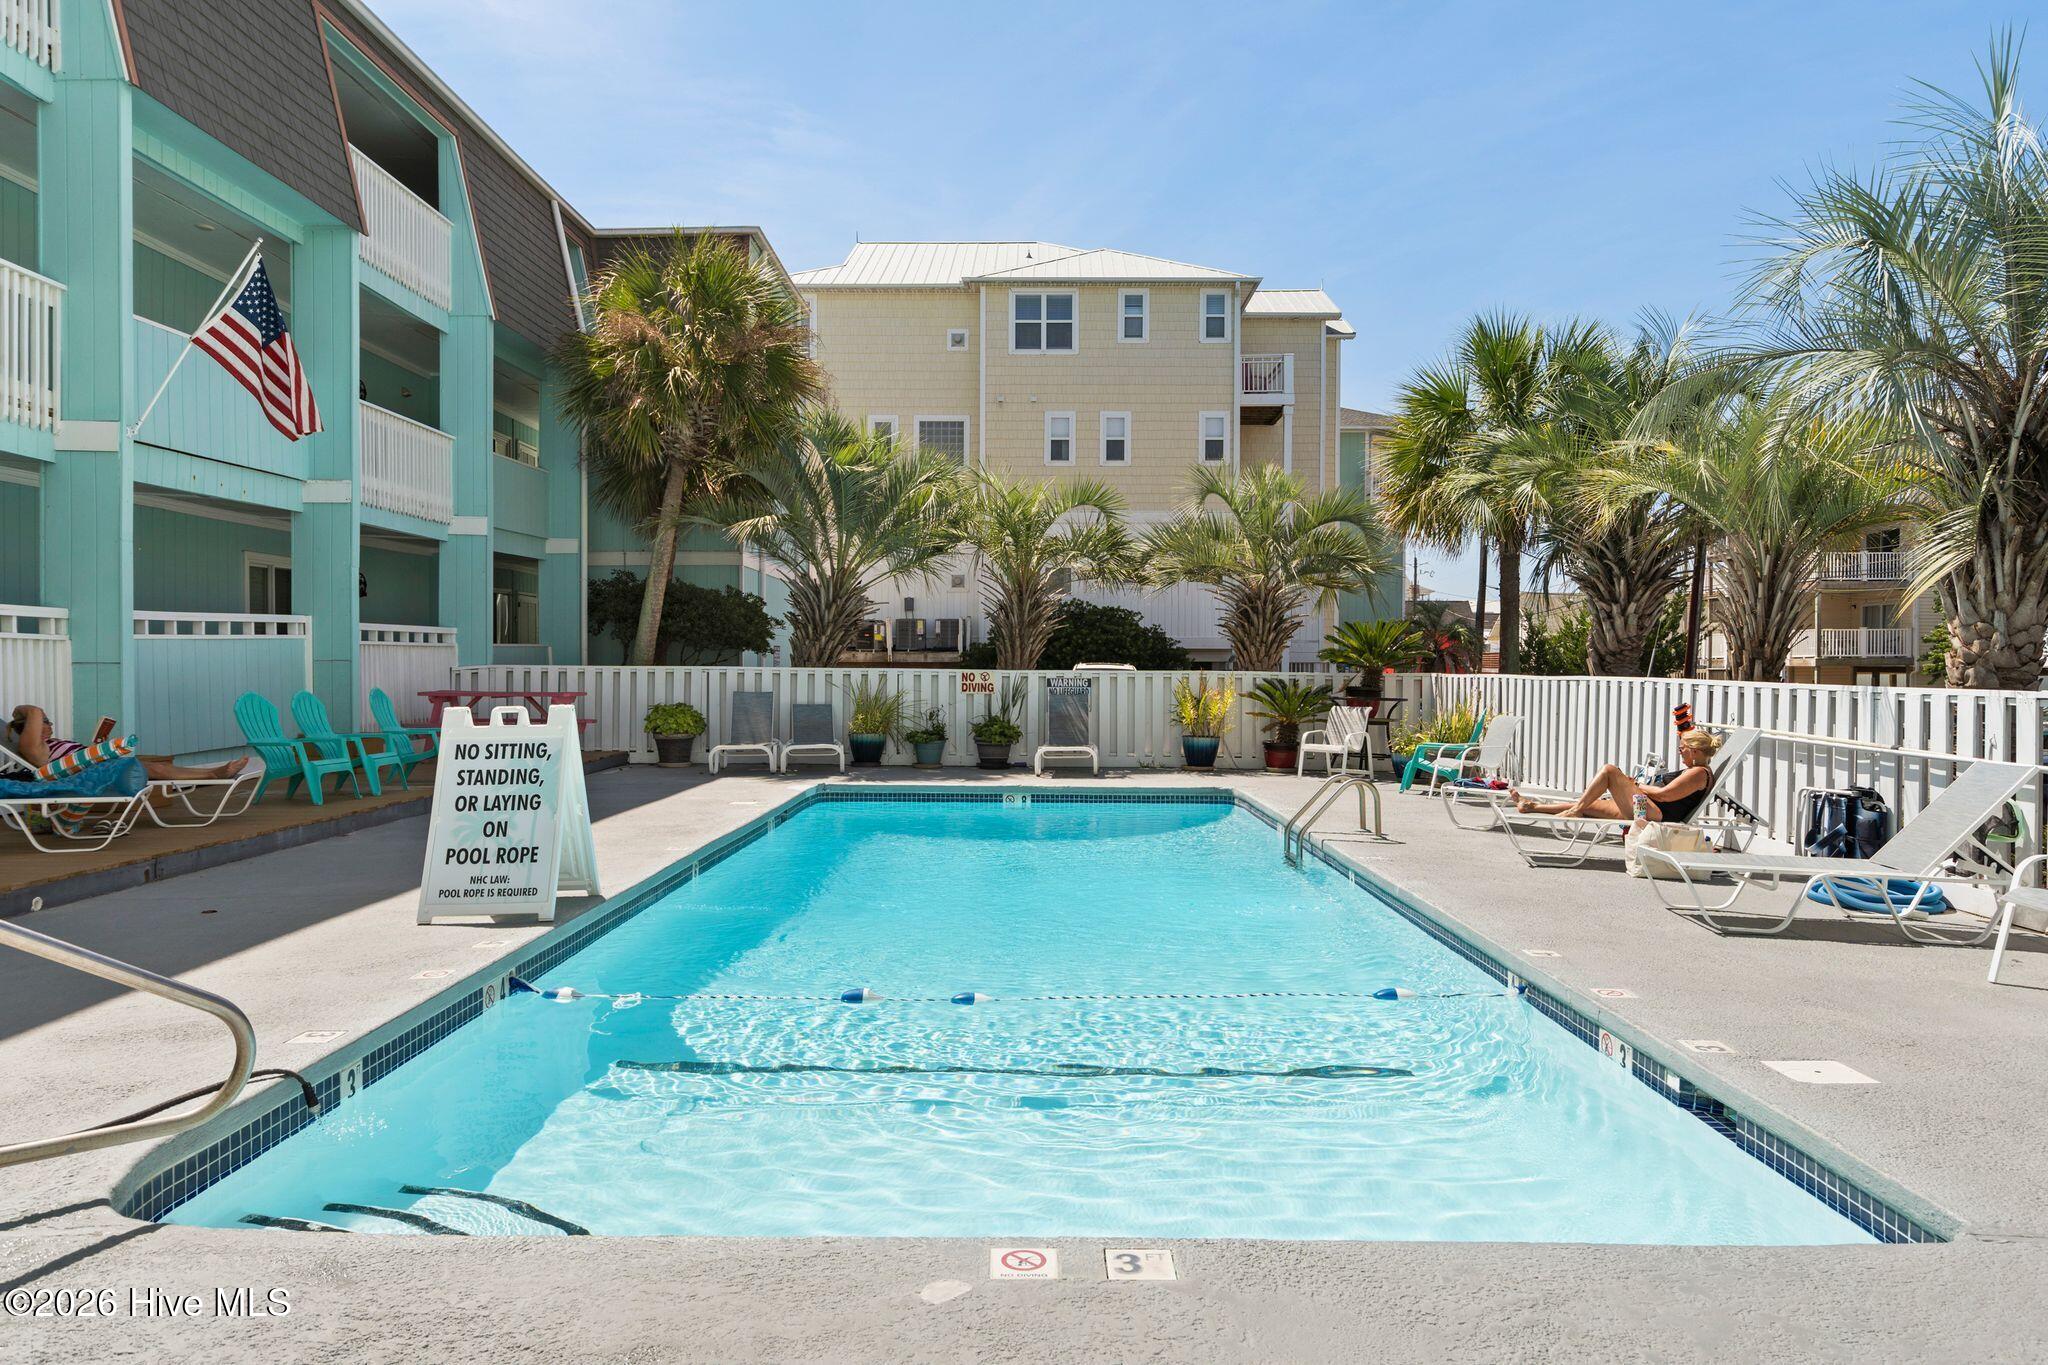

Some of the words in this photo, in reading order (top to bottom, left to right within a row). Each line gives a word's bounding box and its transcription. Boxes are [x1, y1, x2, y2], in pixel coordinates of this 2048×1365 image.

[961, 672, 976, 682] NO
[1050, 678, 1089, 687] WARNING
[961, 682, 994, 692] DIVING
[454, 743, 480, 760] NO
[484, 742, 552, 761] SITTING,
[456, 768, 545, 787] STANDING,
[454, 795, 479, 812] OR
[483, 793, 542, 811] LAYING
[482, 820, 509, 838] ON
[445, 847, 491, 865] POOL
[495, 846, 540, 865] ROPE
[469, 875, 488, 885] NHC
[489, 875, 511, 885] LAW:
[438, 888, 462, 899] POOL
[463, 888, 486, 898] ROPE
[487, 888, 496, 898] IS
[496, 887, 539, 898] REQUIRED
[1619, 1043, 1626, 1069] 3
[347, 1068, 357, 1099] 3
[1114, 1253, 1143, 1274] 3
[1145, 1252, 1164, 1262] FT
